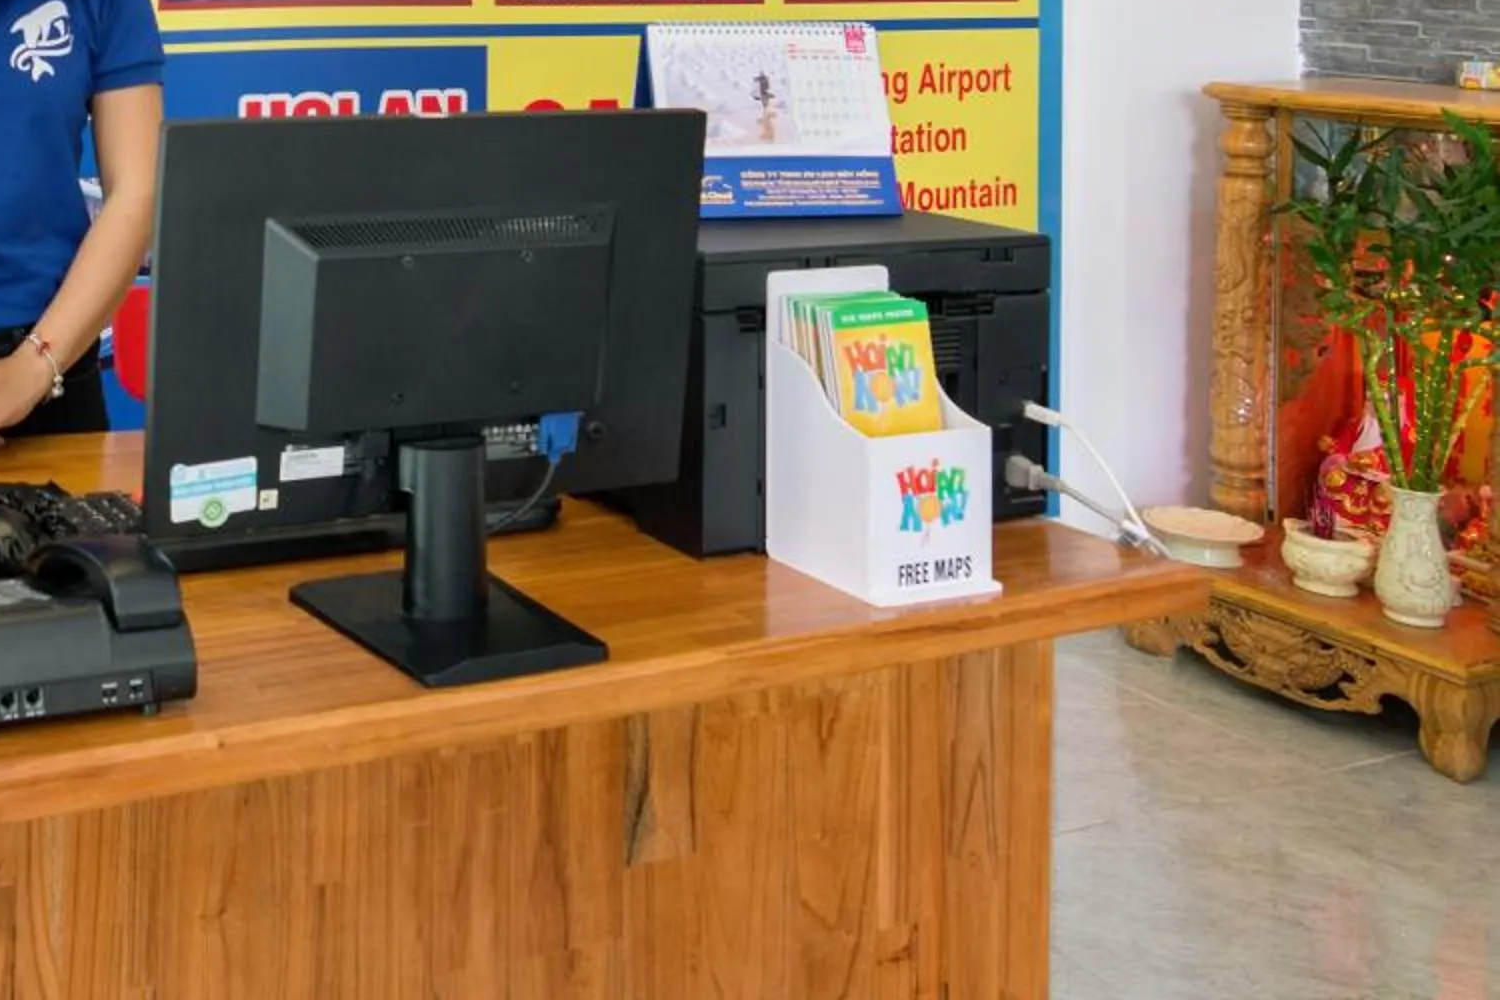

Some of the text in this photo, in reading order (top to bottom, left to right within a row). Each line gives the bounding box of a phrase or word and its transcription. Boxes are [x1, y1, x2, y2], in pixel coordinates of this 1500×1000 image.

[881, 62, 1012, 104] ng Airport
[891, 121, 966, 154] tation
[898, 555, 972, 587] FREE MAPS
